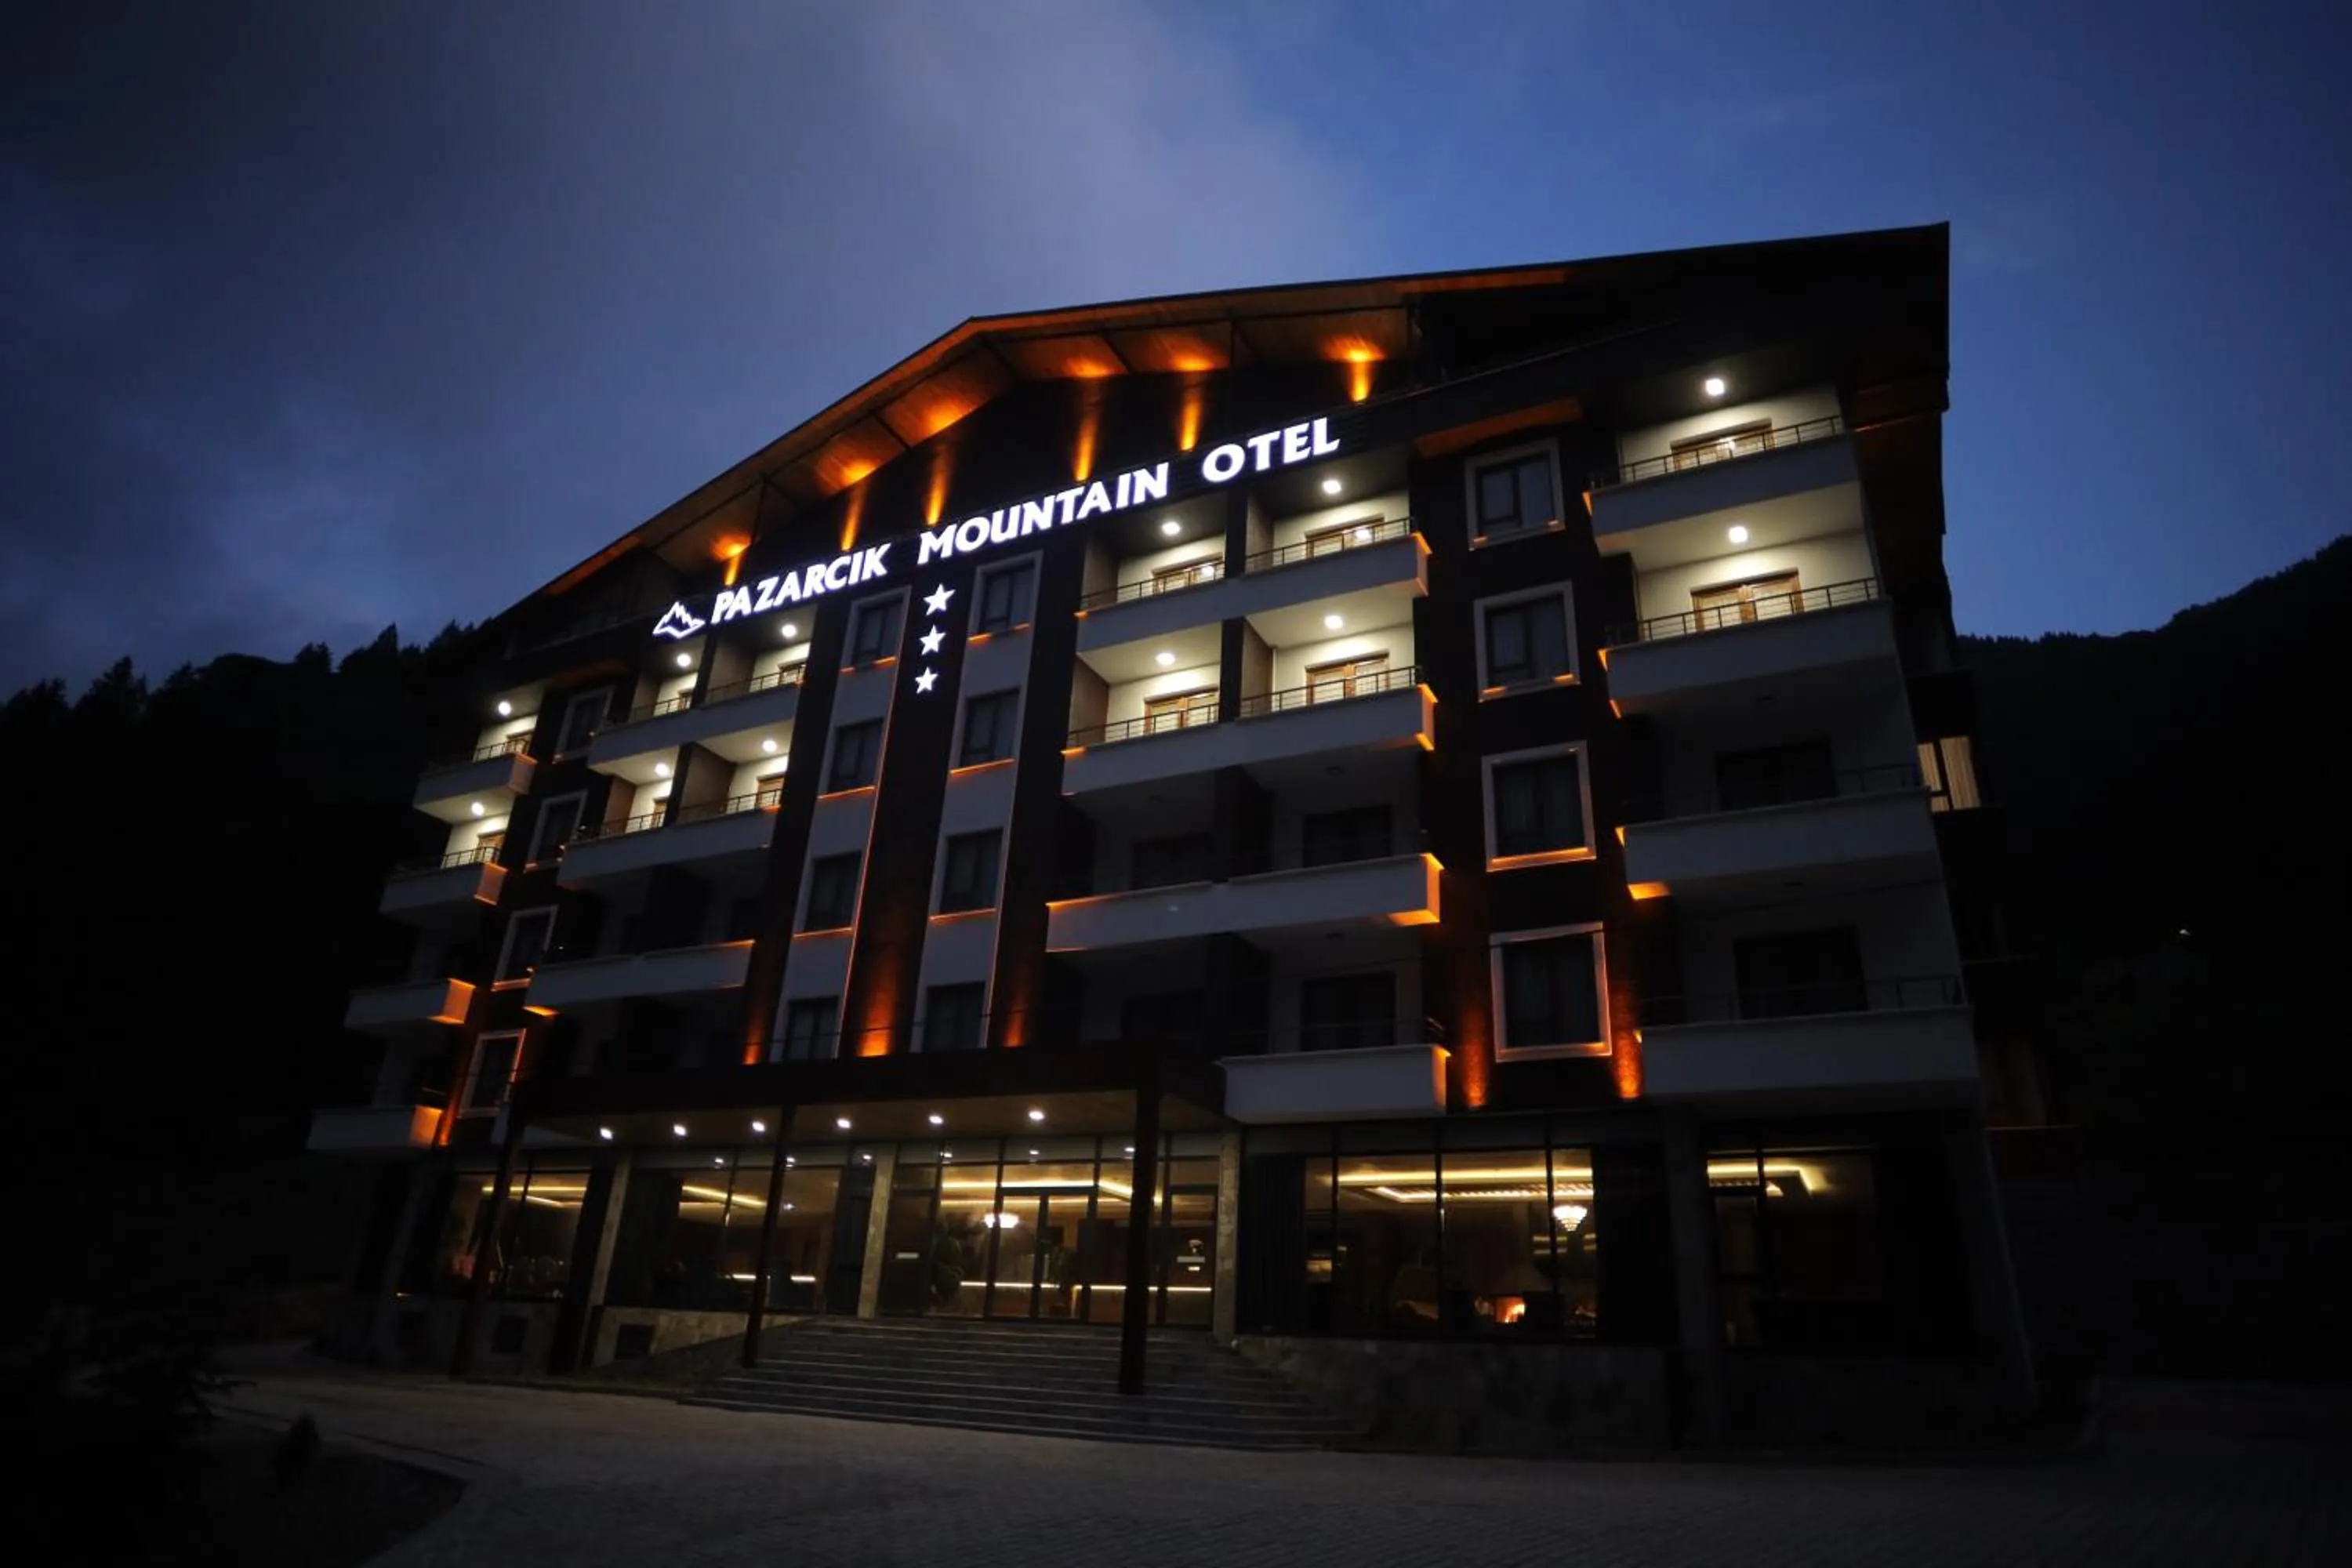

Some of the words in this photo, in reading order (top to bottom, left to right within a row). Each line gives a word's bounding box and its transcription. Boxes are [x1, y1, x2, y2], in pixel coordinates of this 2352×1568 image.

[710, 543, 891, 624] PAZARCIK
[917, 462, 1169, 564] MOUNTAIN
[1202, 417, 1340, 482] OTEL
